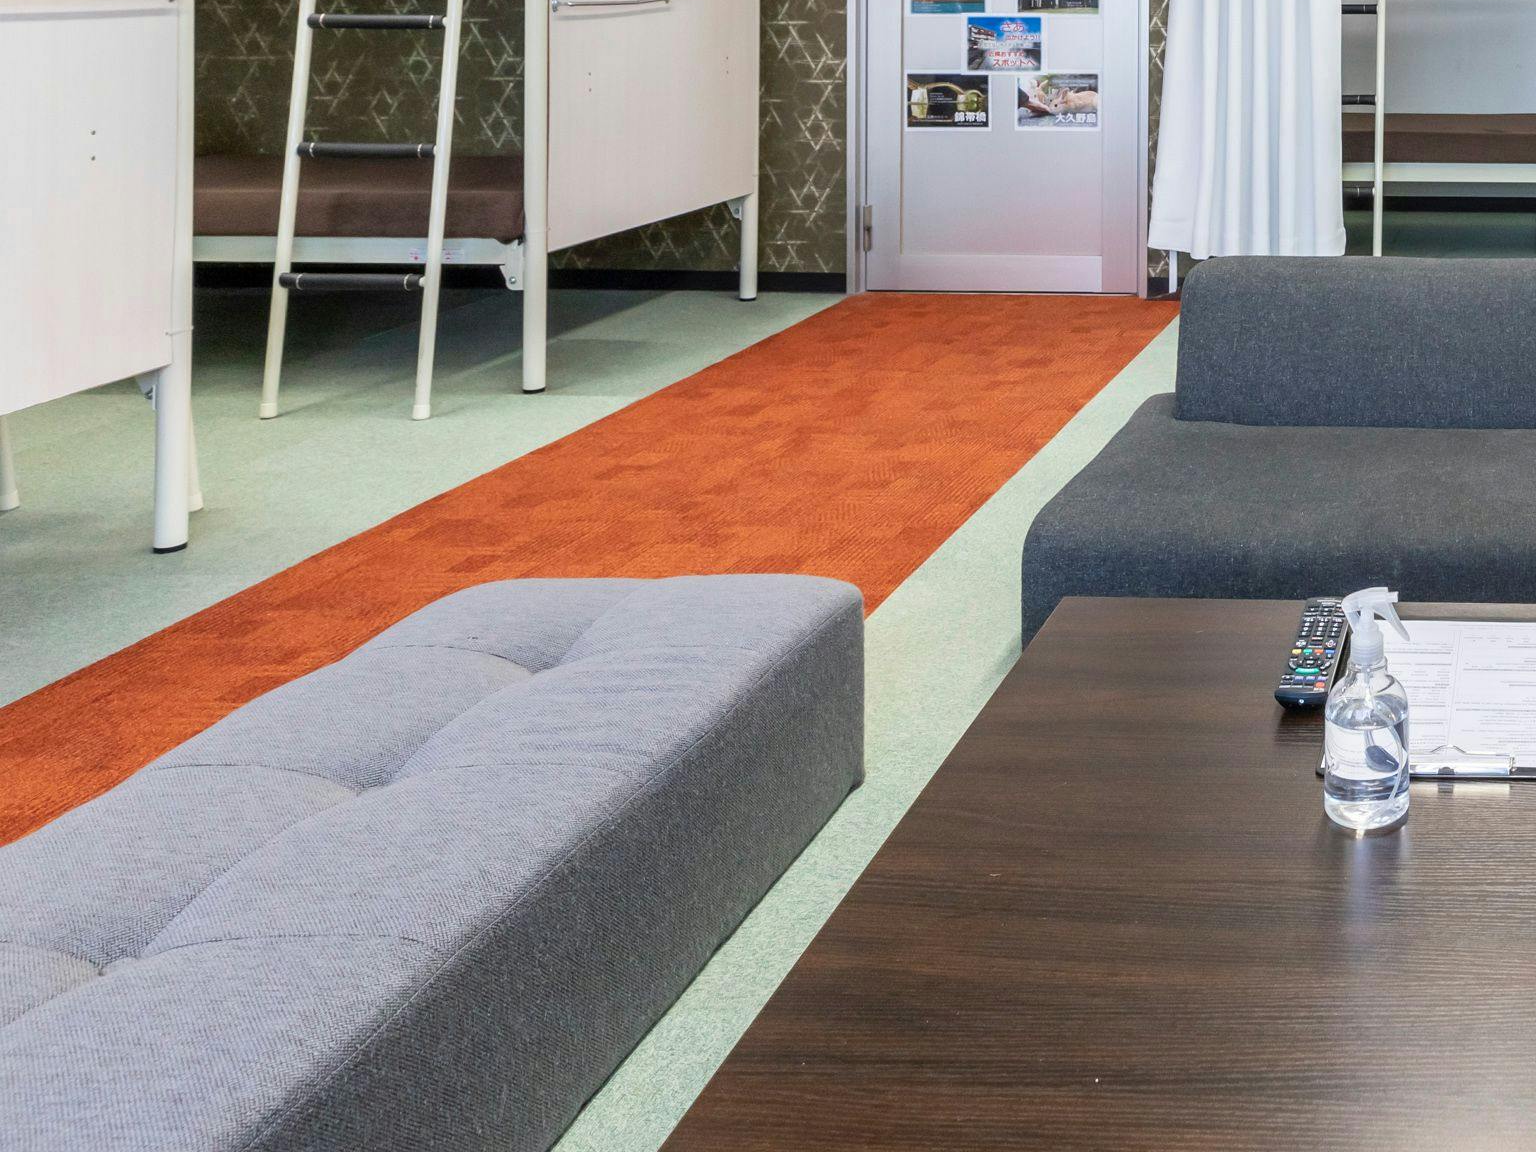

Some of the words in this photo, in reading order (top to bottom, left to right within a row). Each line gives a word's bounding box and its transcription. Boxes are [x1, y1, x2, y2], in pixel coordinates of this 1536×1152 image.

[1001, 21, 1025, 33] さあ
[993, 58, 1036, 67] スポットへ
[1055, 113, 1096, 123] 大久野島
